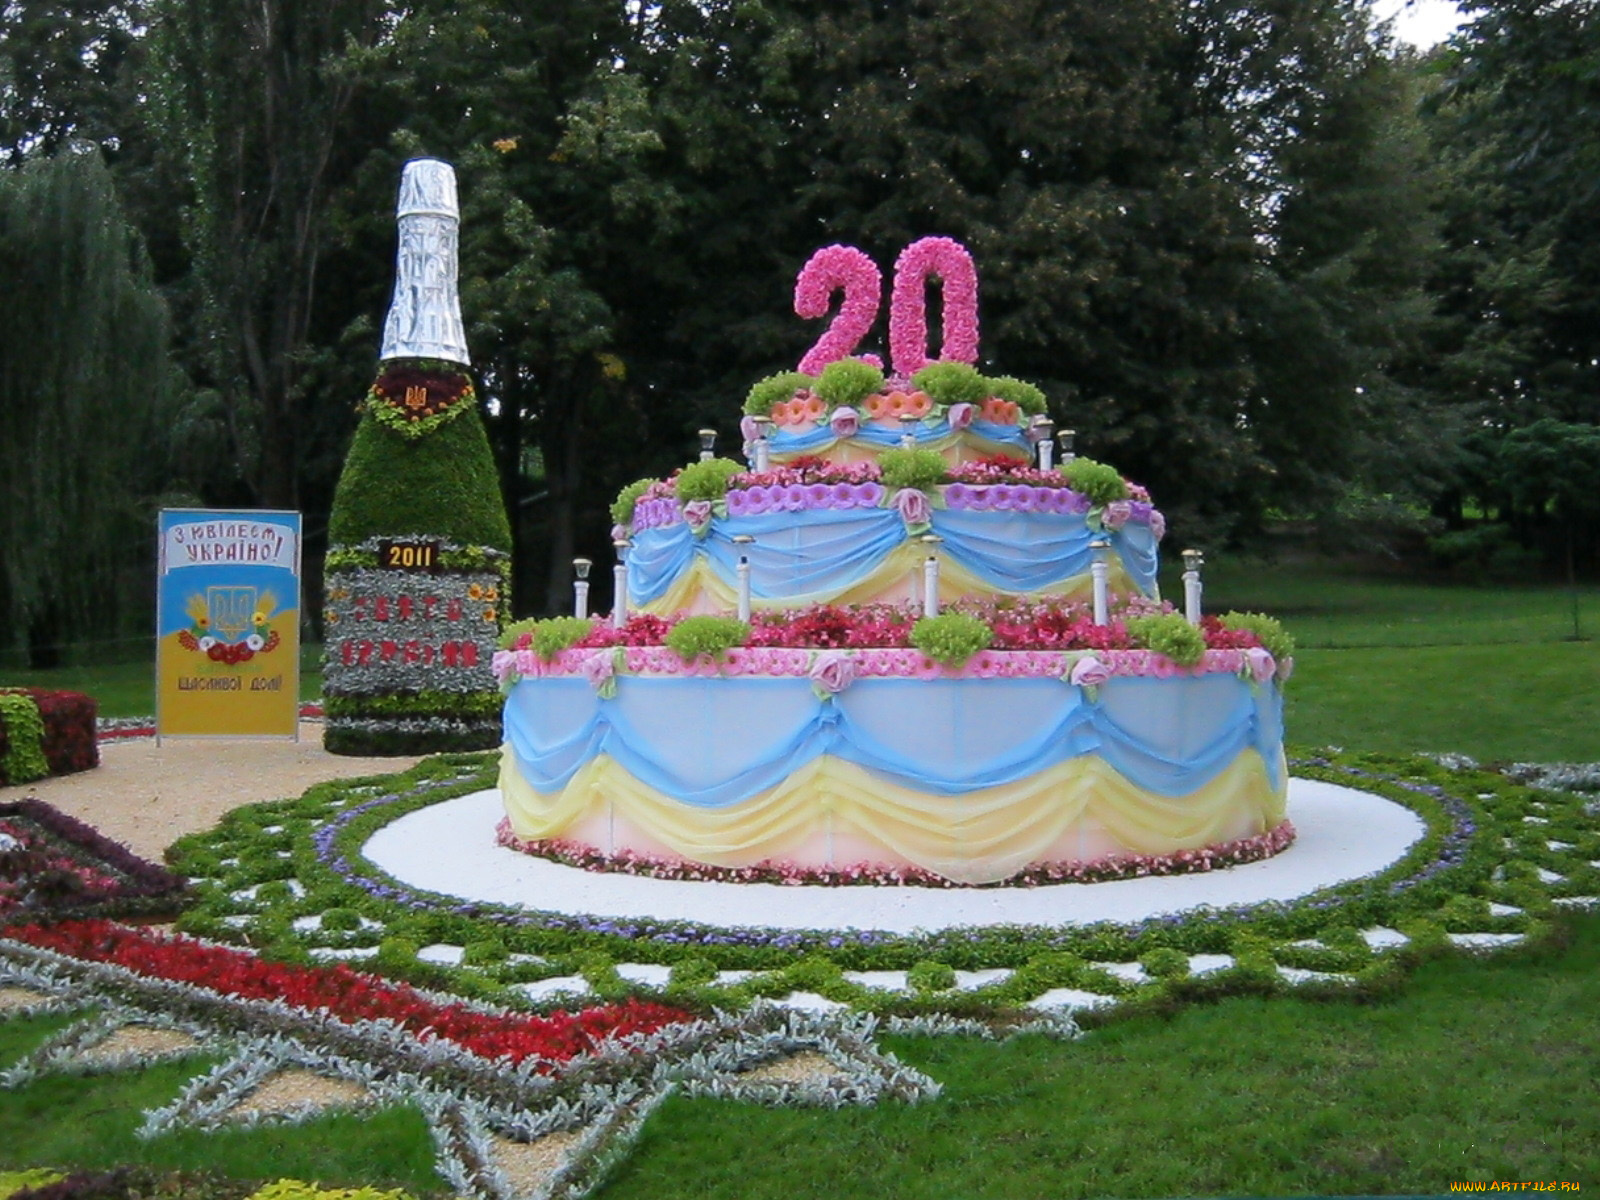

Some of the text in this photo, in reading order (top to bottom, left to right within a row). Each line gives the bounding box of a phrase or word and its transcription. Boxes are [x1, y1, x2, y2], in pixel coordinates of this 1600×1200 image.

[794, 236, 980, 377] 20
[175, 522, 276, 543] З ЮВІЛЕЄМ
[187, 536, 284, 562] УКРАЇНО!
[389, 546, 431, 567] 2011
